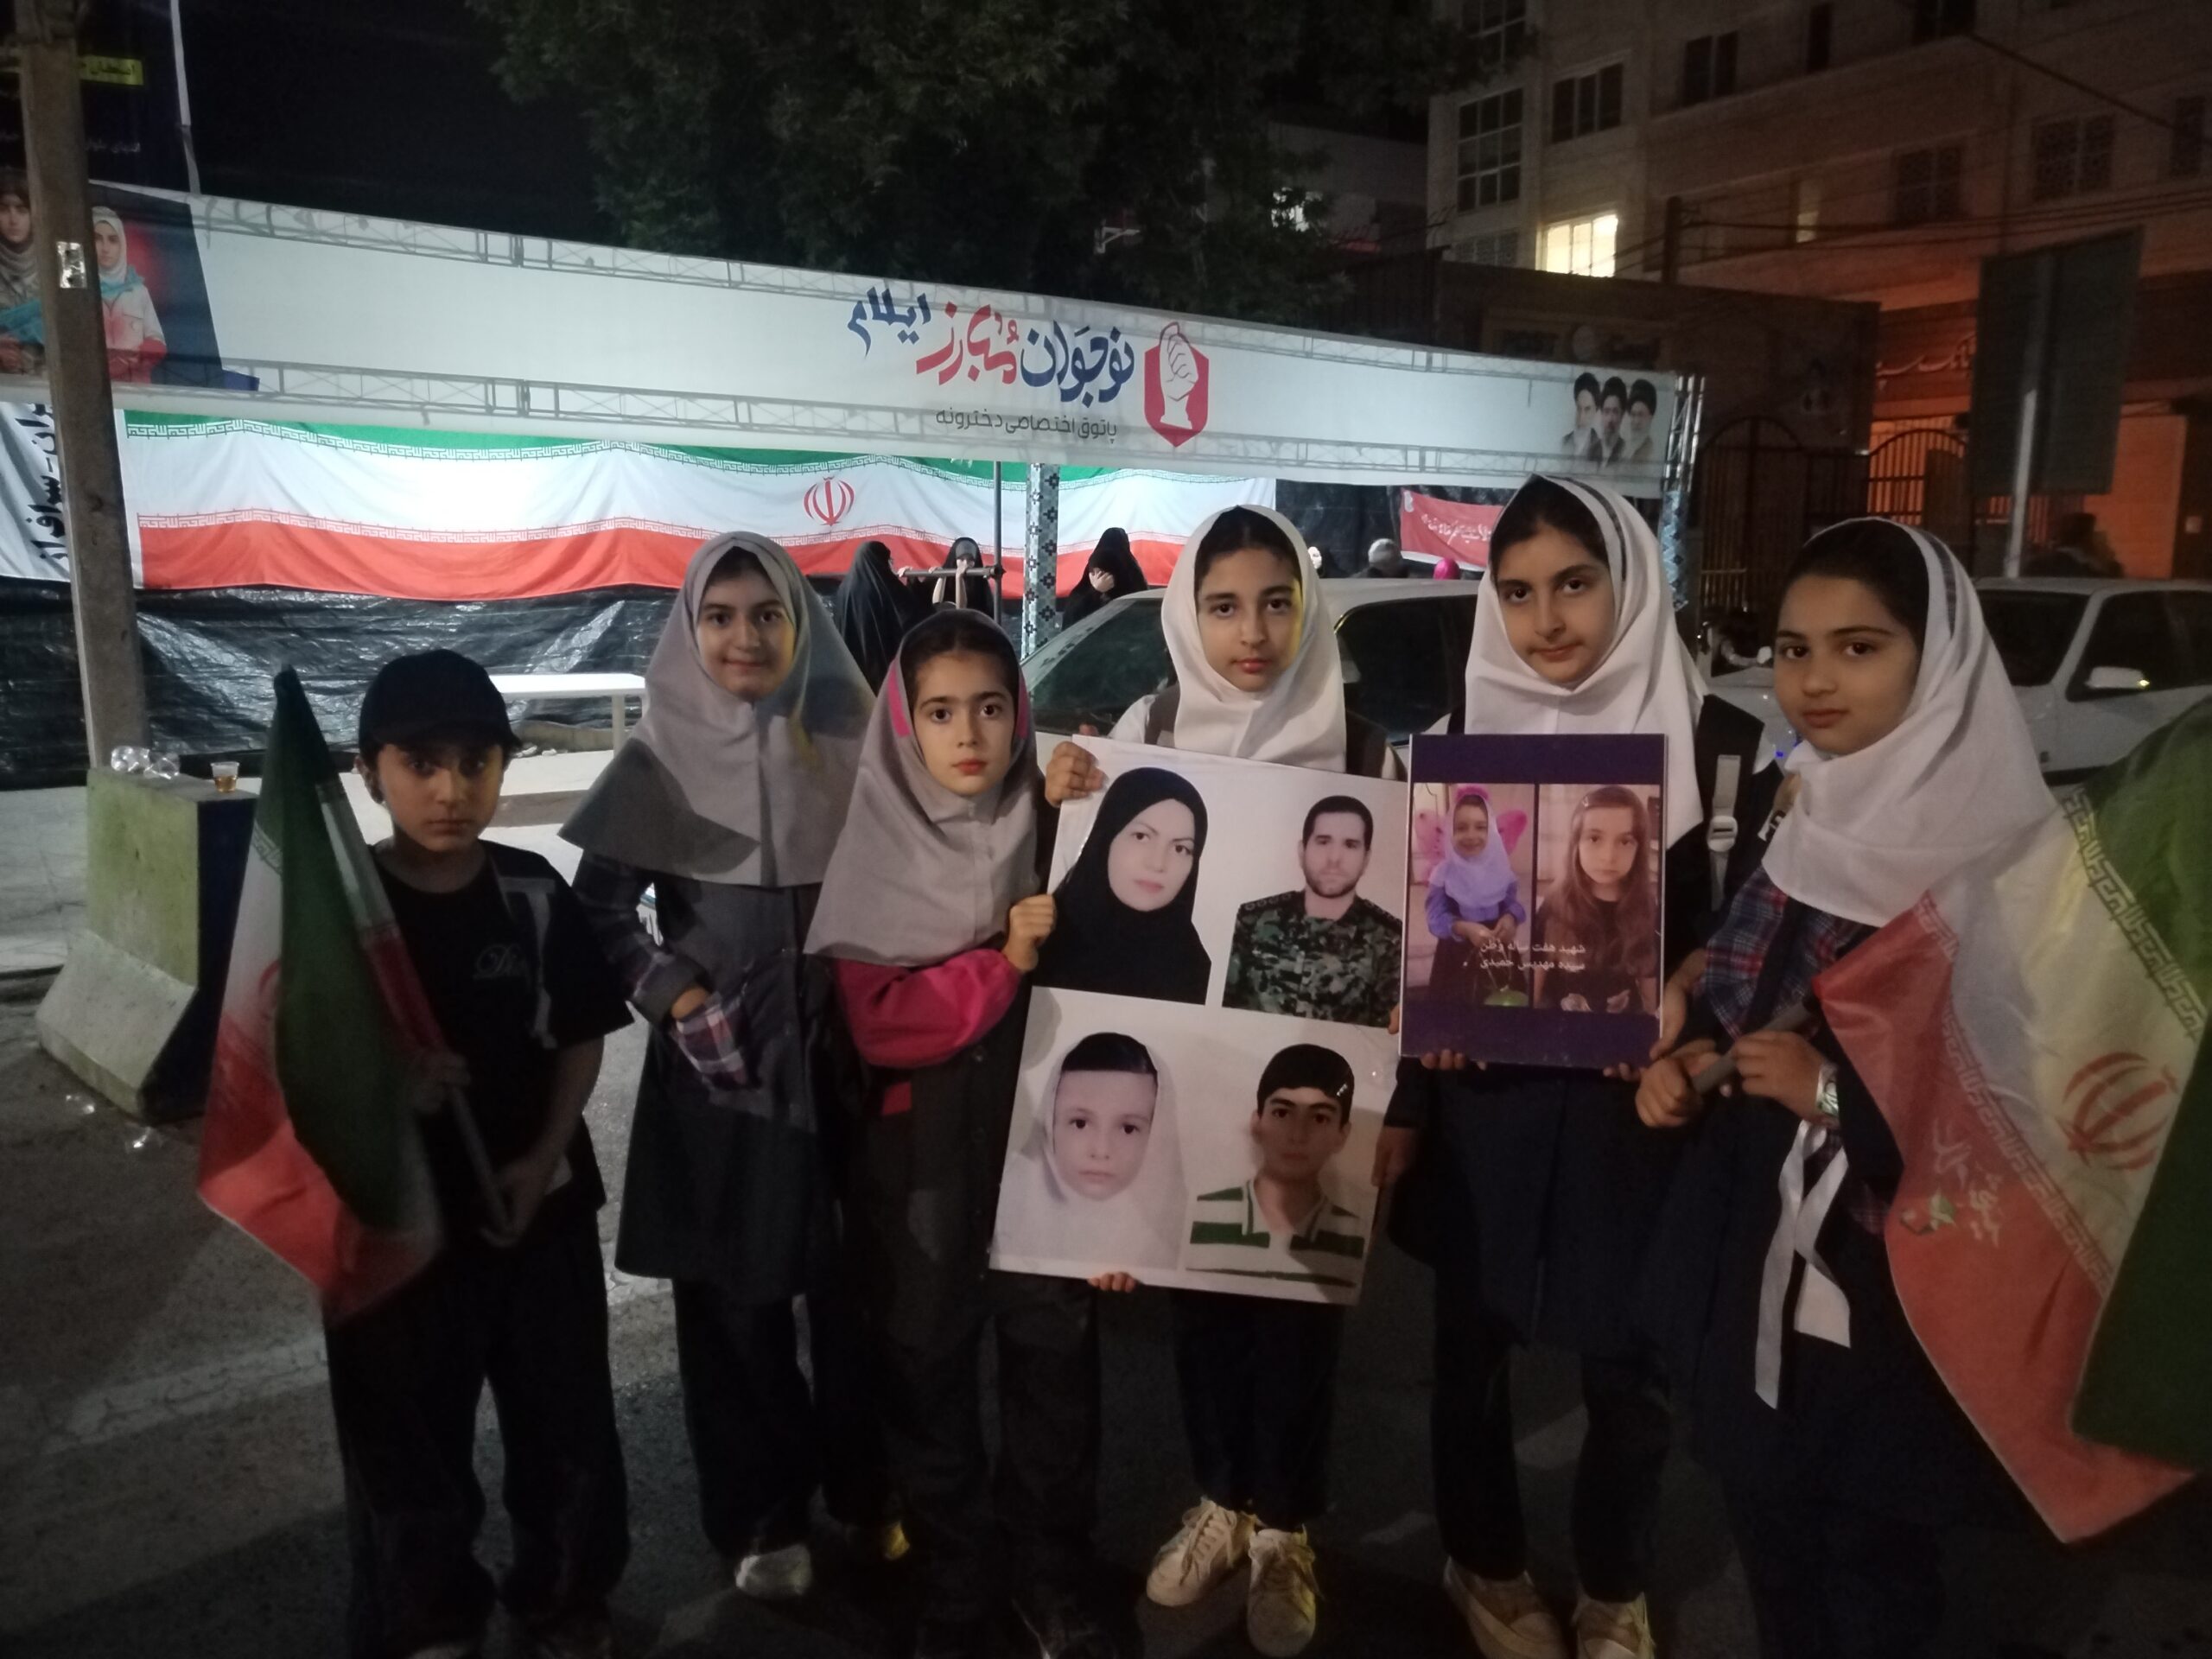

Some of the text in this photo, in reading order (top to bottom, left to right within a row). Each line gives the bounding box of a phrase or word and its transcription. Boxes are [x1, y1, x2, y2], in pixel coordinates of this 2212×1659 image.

[847, 286, 932, 361] ایلام
[936, 407, 1118, 444] پاتوق اختصاصی دخترونه
